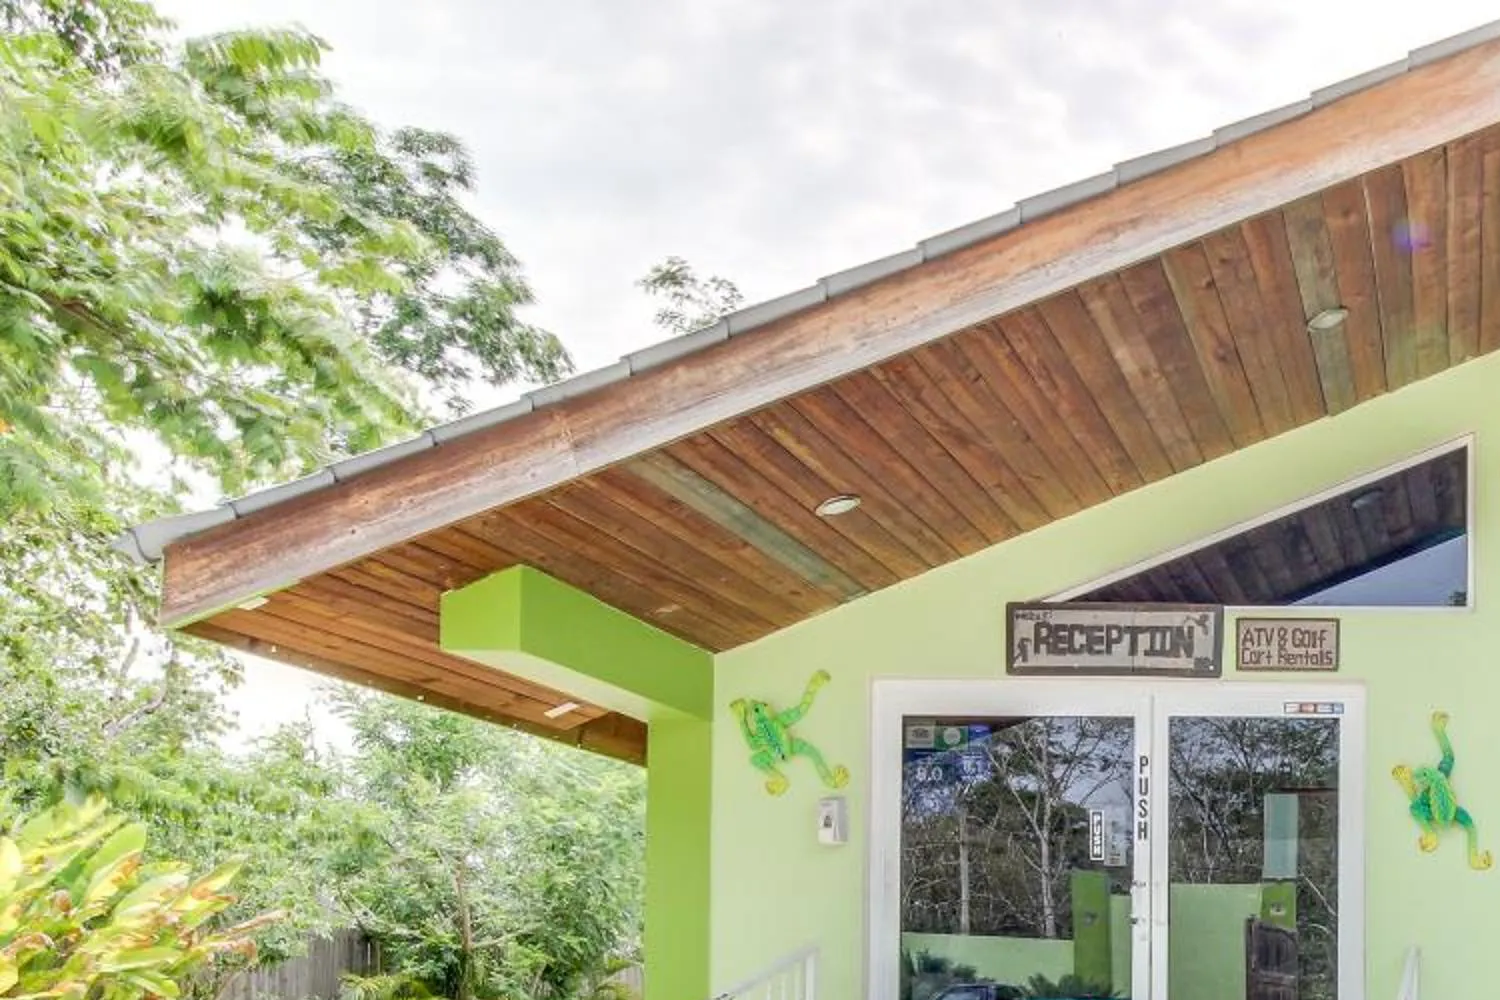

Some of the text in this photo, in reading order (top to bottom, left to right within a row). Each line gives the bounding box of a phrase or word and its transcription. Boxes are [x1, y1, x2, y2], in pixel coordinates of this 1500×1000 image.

[1033, 621, 1194, 657] RECEPTION
[1242, 627, 1274, 647] ATV
[1277, 626, 1288, 648] &
[1242, 647, 1333, 665] Cart Rentals
[1138, 755, 1149, 841] PUSH
